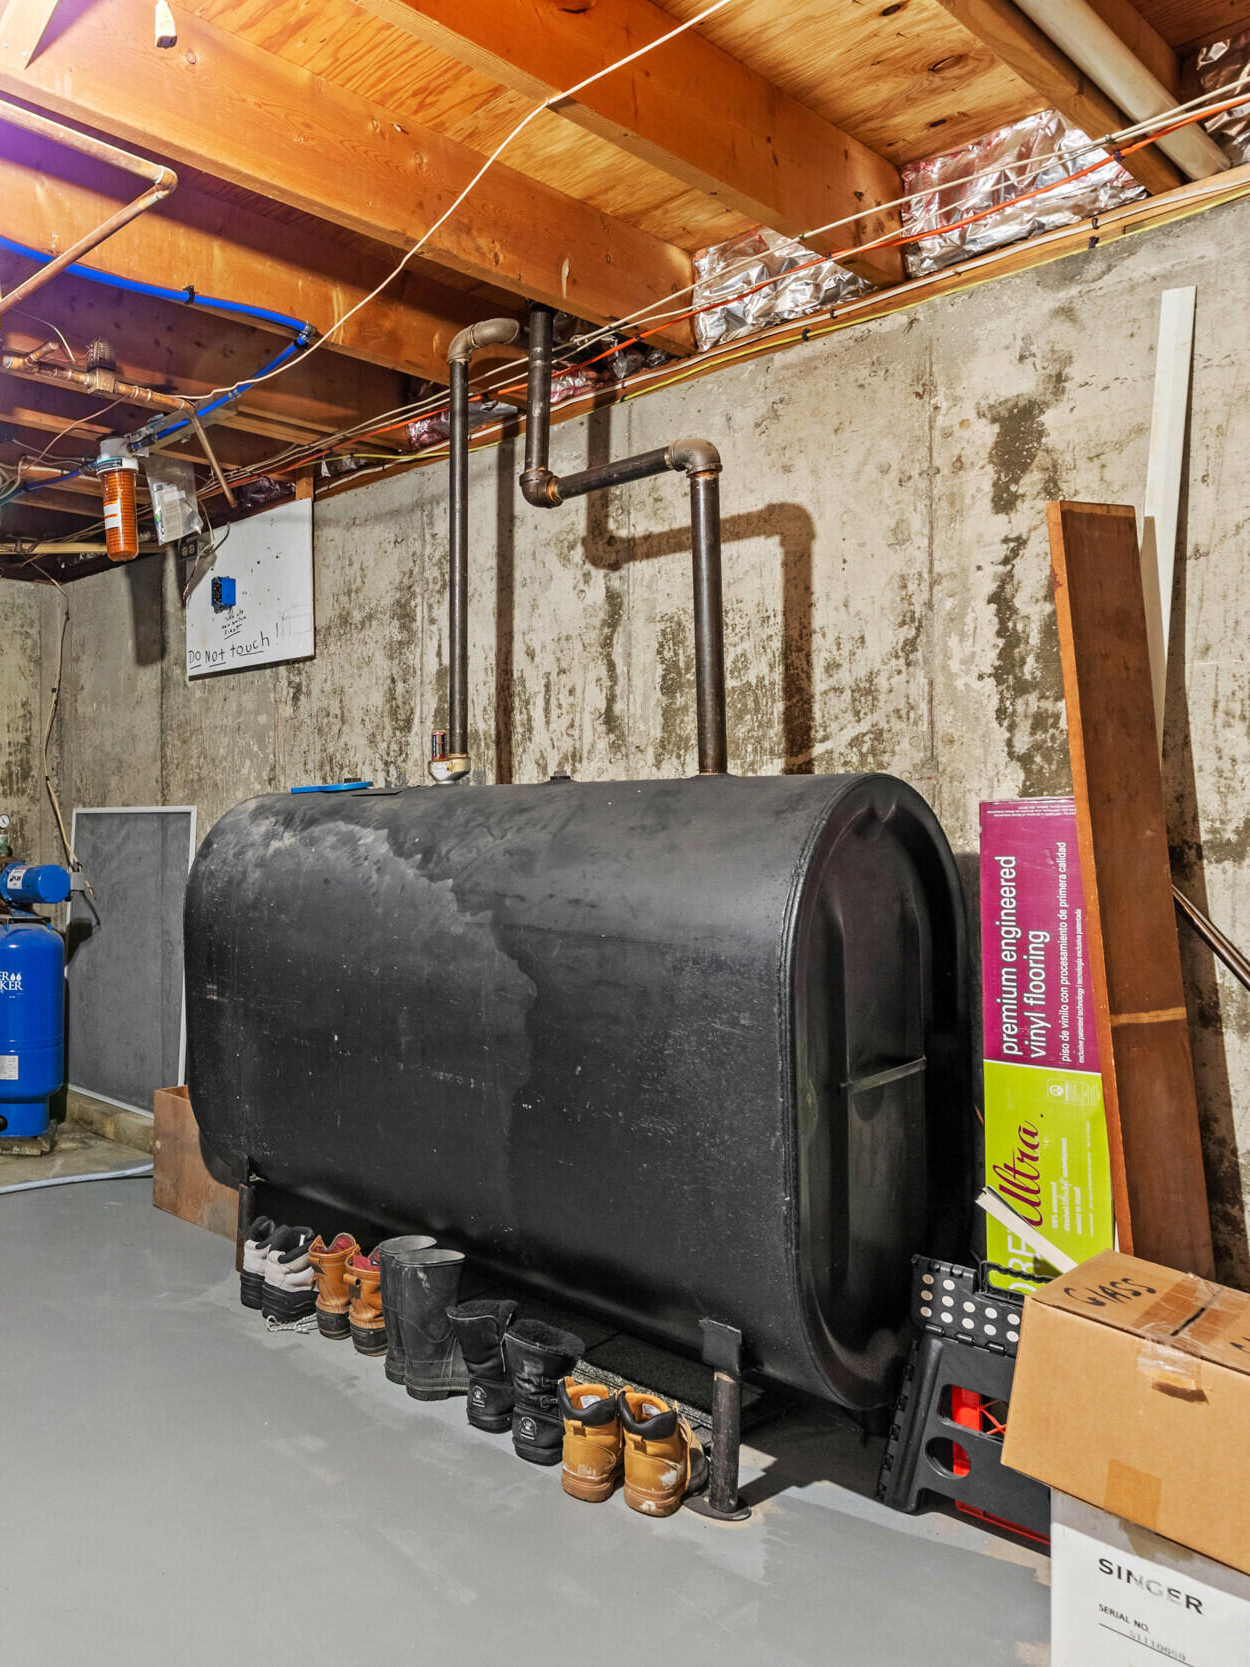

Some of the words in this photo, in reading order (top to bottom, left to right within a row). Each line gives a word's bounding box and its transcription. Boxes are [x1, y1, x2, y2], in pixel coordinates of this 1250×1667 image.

[188, 649, 201, 664] DO
[230, 631, 270, 658] touch
[1056, 842, 1066, 872] calidad
[1056, 874, 1069, 907] primera
[994, 856, 1022, 962] engineered
[1057, 909, 1067, 920] de
[1023, 930, 1050, 1006] flooring
[1057, 922, 1070, 985] procesamiento
[996, 967, 1022, 1055] premium
[1059, 987, 1068, 1003] con
[1059, 1004, 1069, 1028] vinilo
[1024, 1011, 1051, 1058] vinyl
[1059, 1030, 1069, 1041] de
[1061, 1043, 1071, 1062] piso
[992, 1121, 1043, 1227] Ultra
[1098, 1558, 1204, 1615] SINGER
[1098, 1603, 1130, 1624] SERIAL
